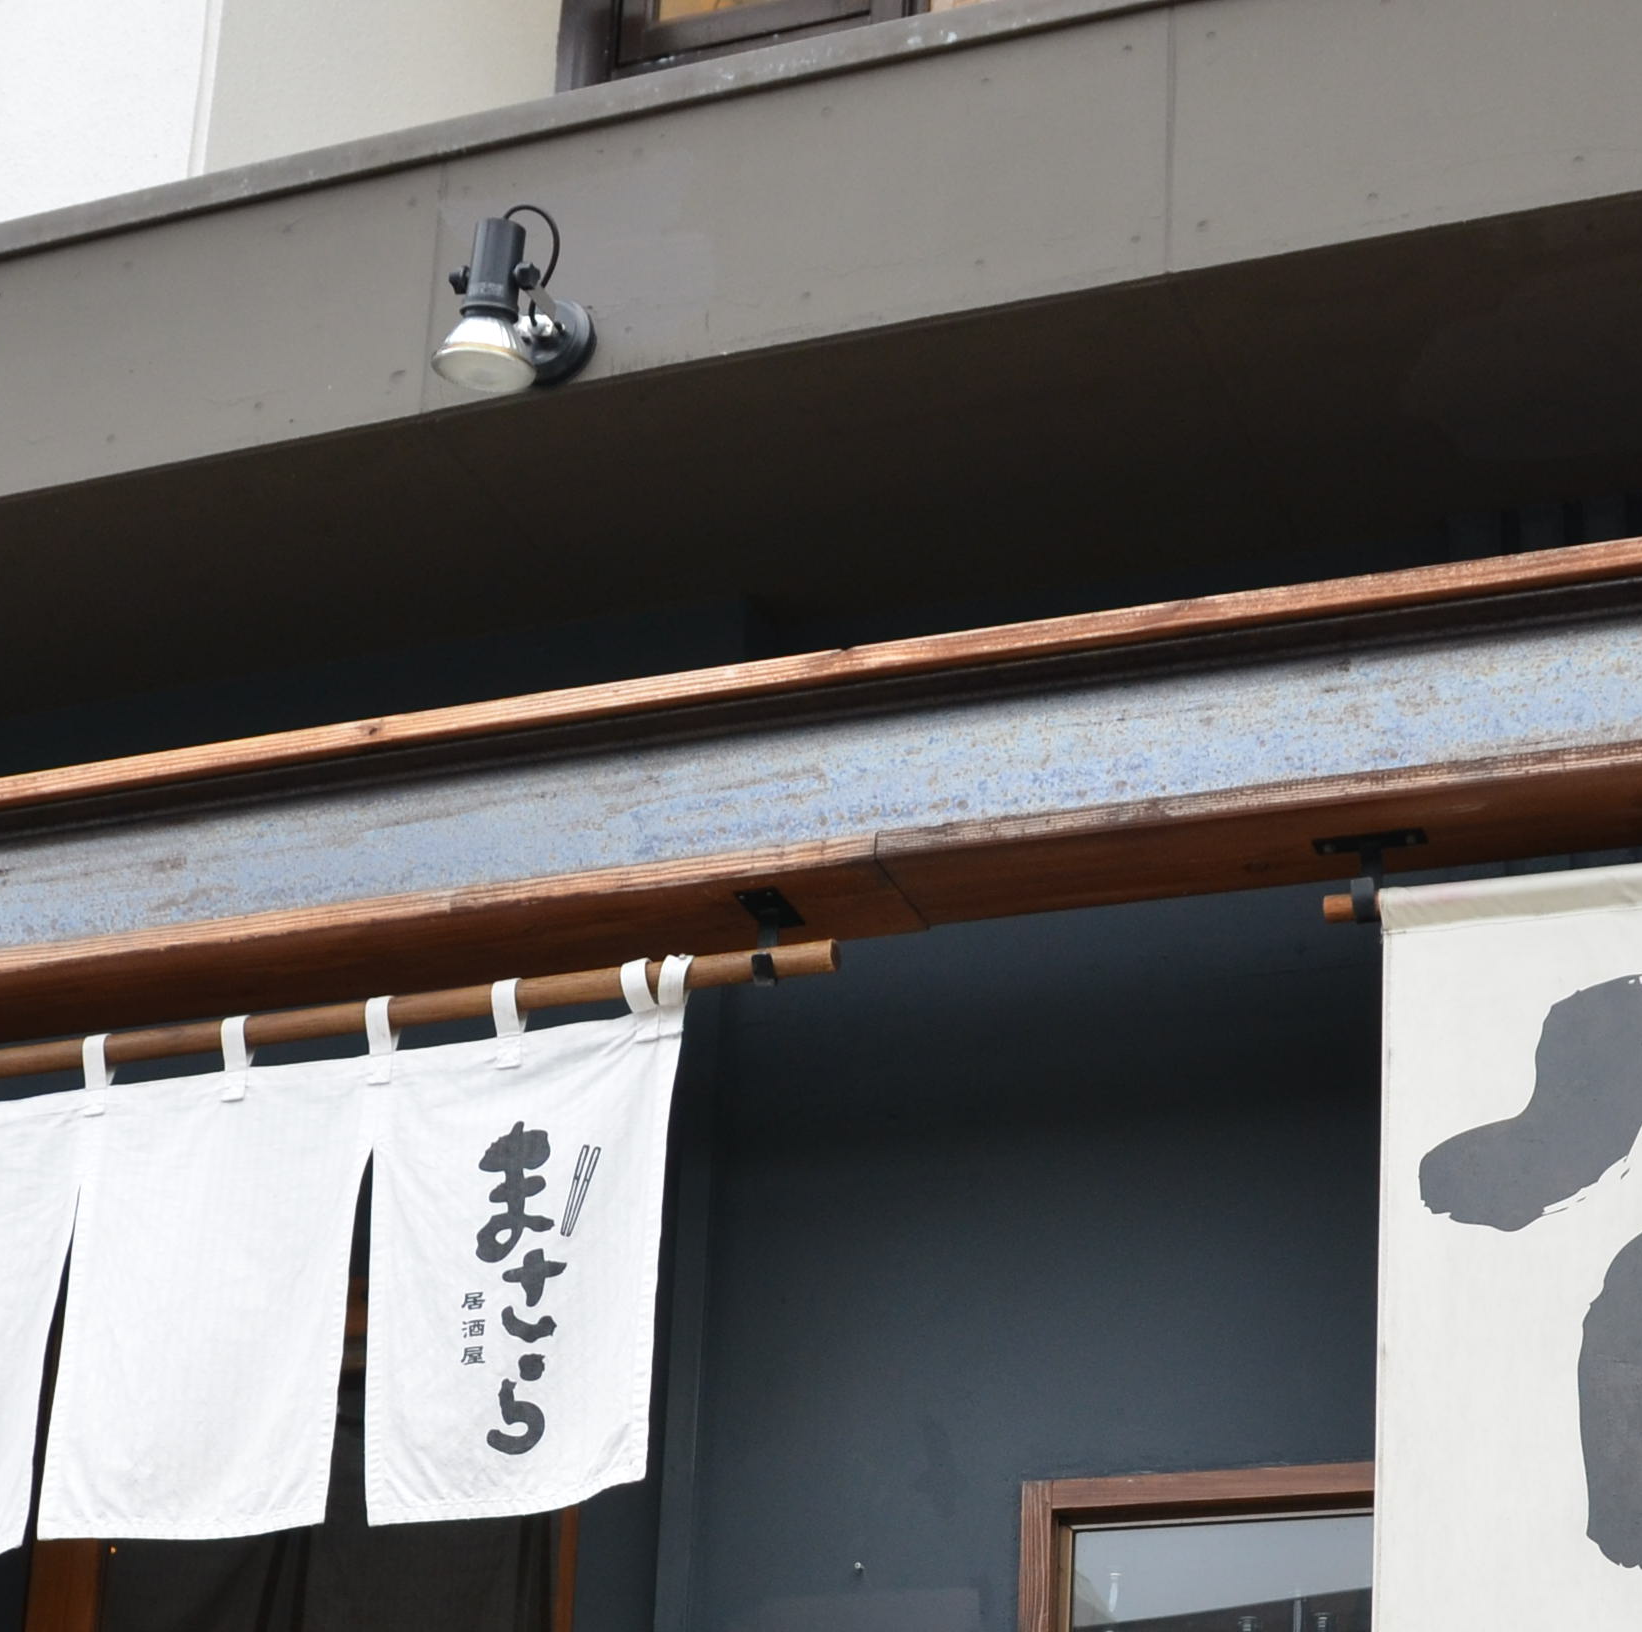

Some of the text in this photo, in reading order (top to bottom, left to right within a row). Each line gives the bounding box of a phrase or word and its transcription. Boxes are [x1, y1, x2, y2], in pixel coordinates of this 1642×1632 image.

[460, 1291, 486, 1366] 居酒屋
[475, 1120, 567, 1455] まさら
